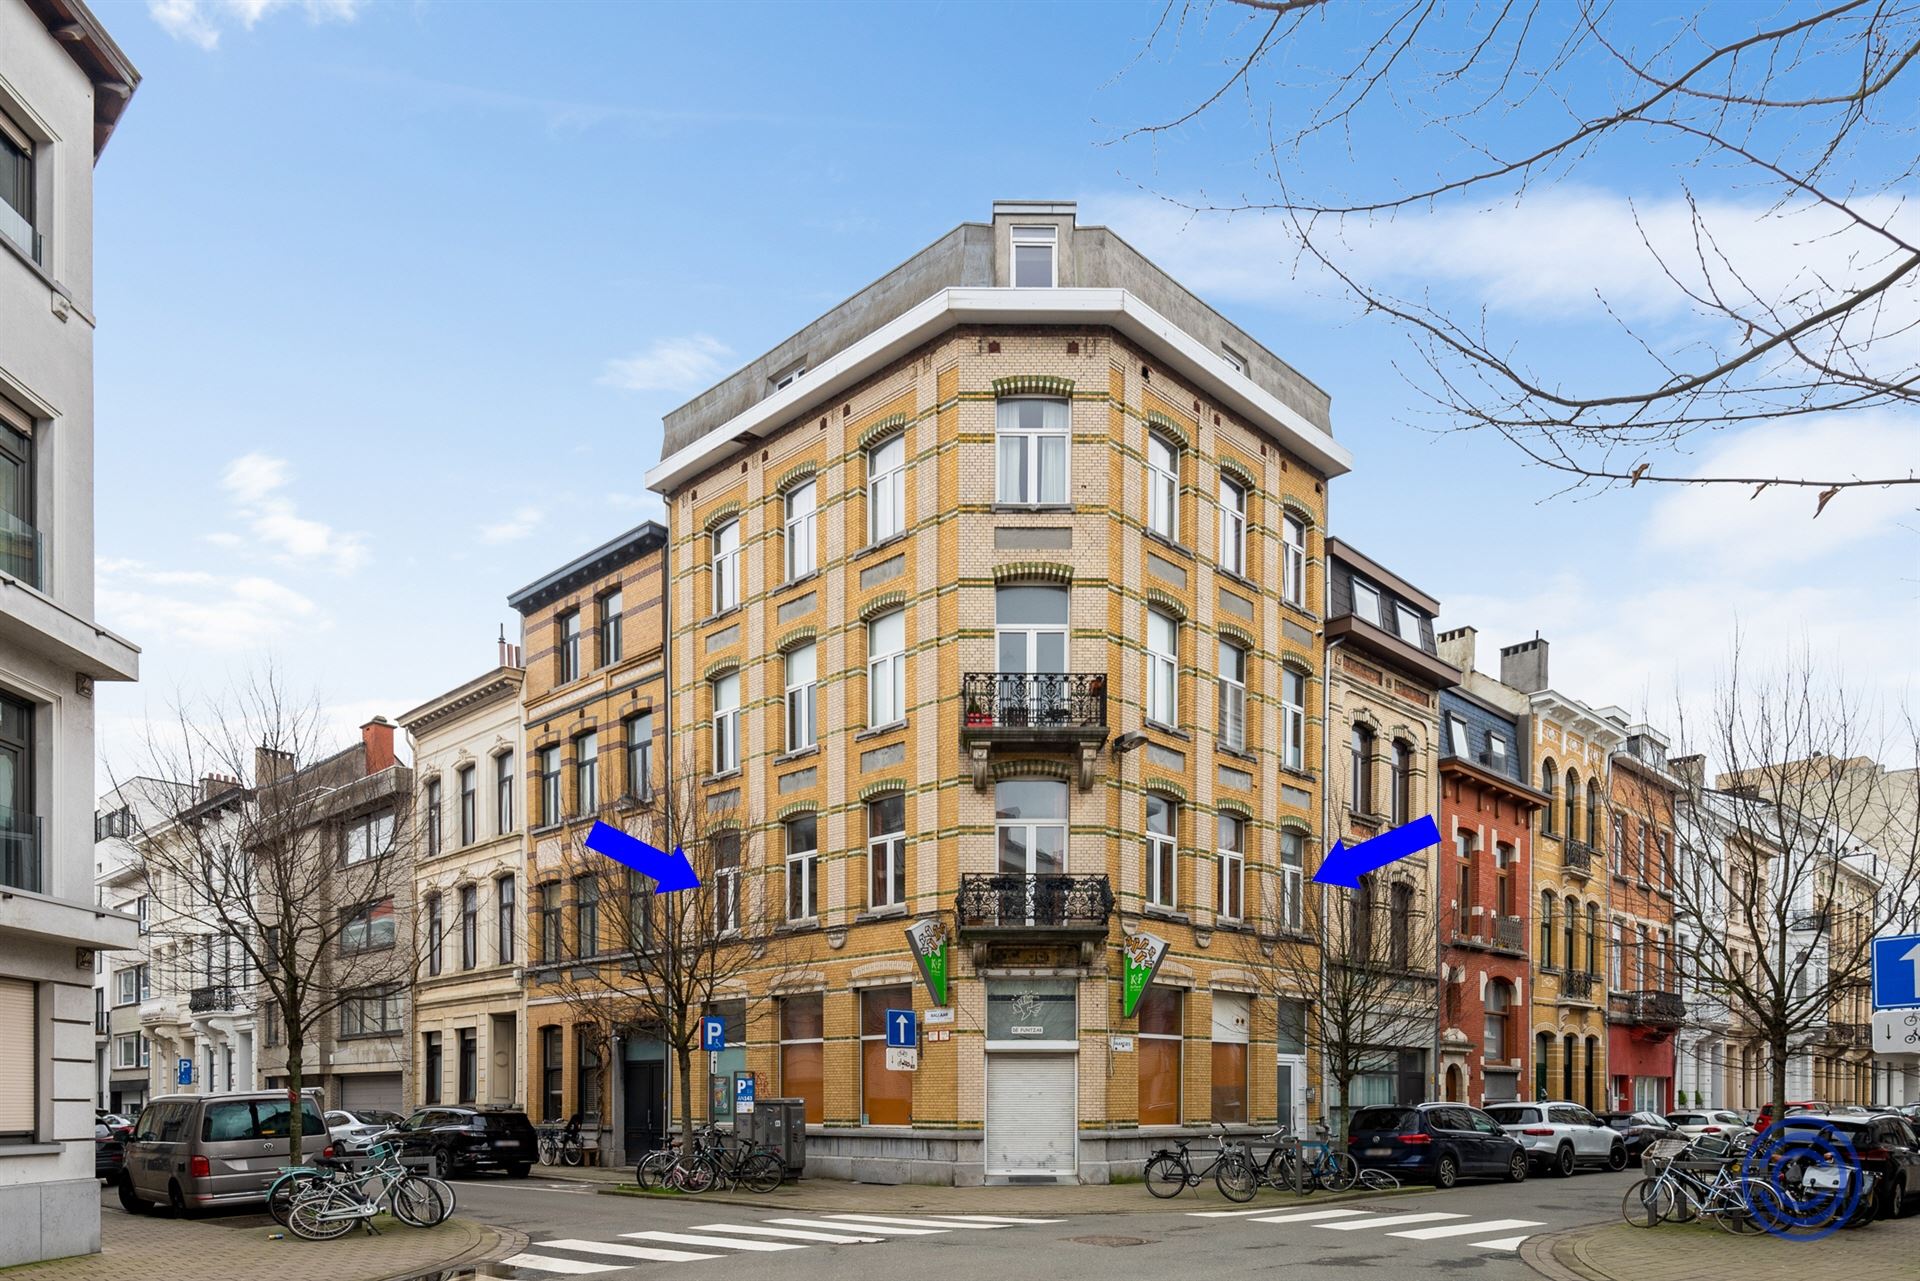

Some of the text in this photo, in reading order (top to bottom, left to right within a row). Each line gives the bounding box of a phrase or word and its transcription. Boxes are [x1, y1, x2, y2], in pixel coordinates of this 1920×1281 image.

[707, 1022, 722, 1045] P
[181, 1061, 191, 1072] P
[737, 1080, 747, 1093] P
